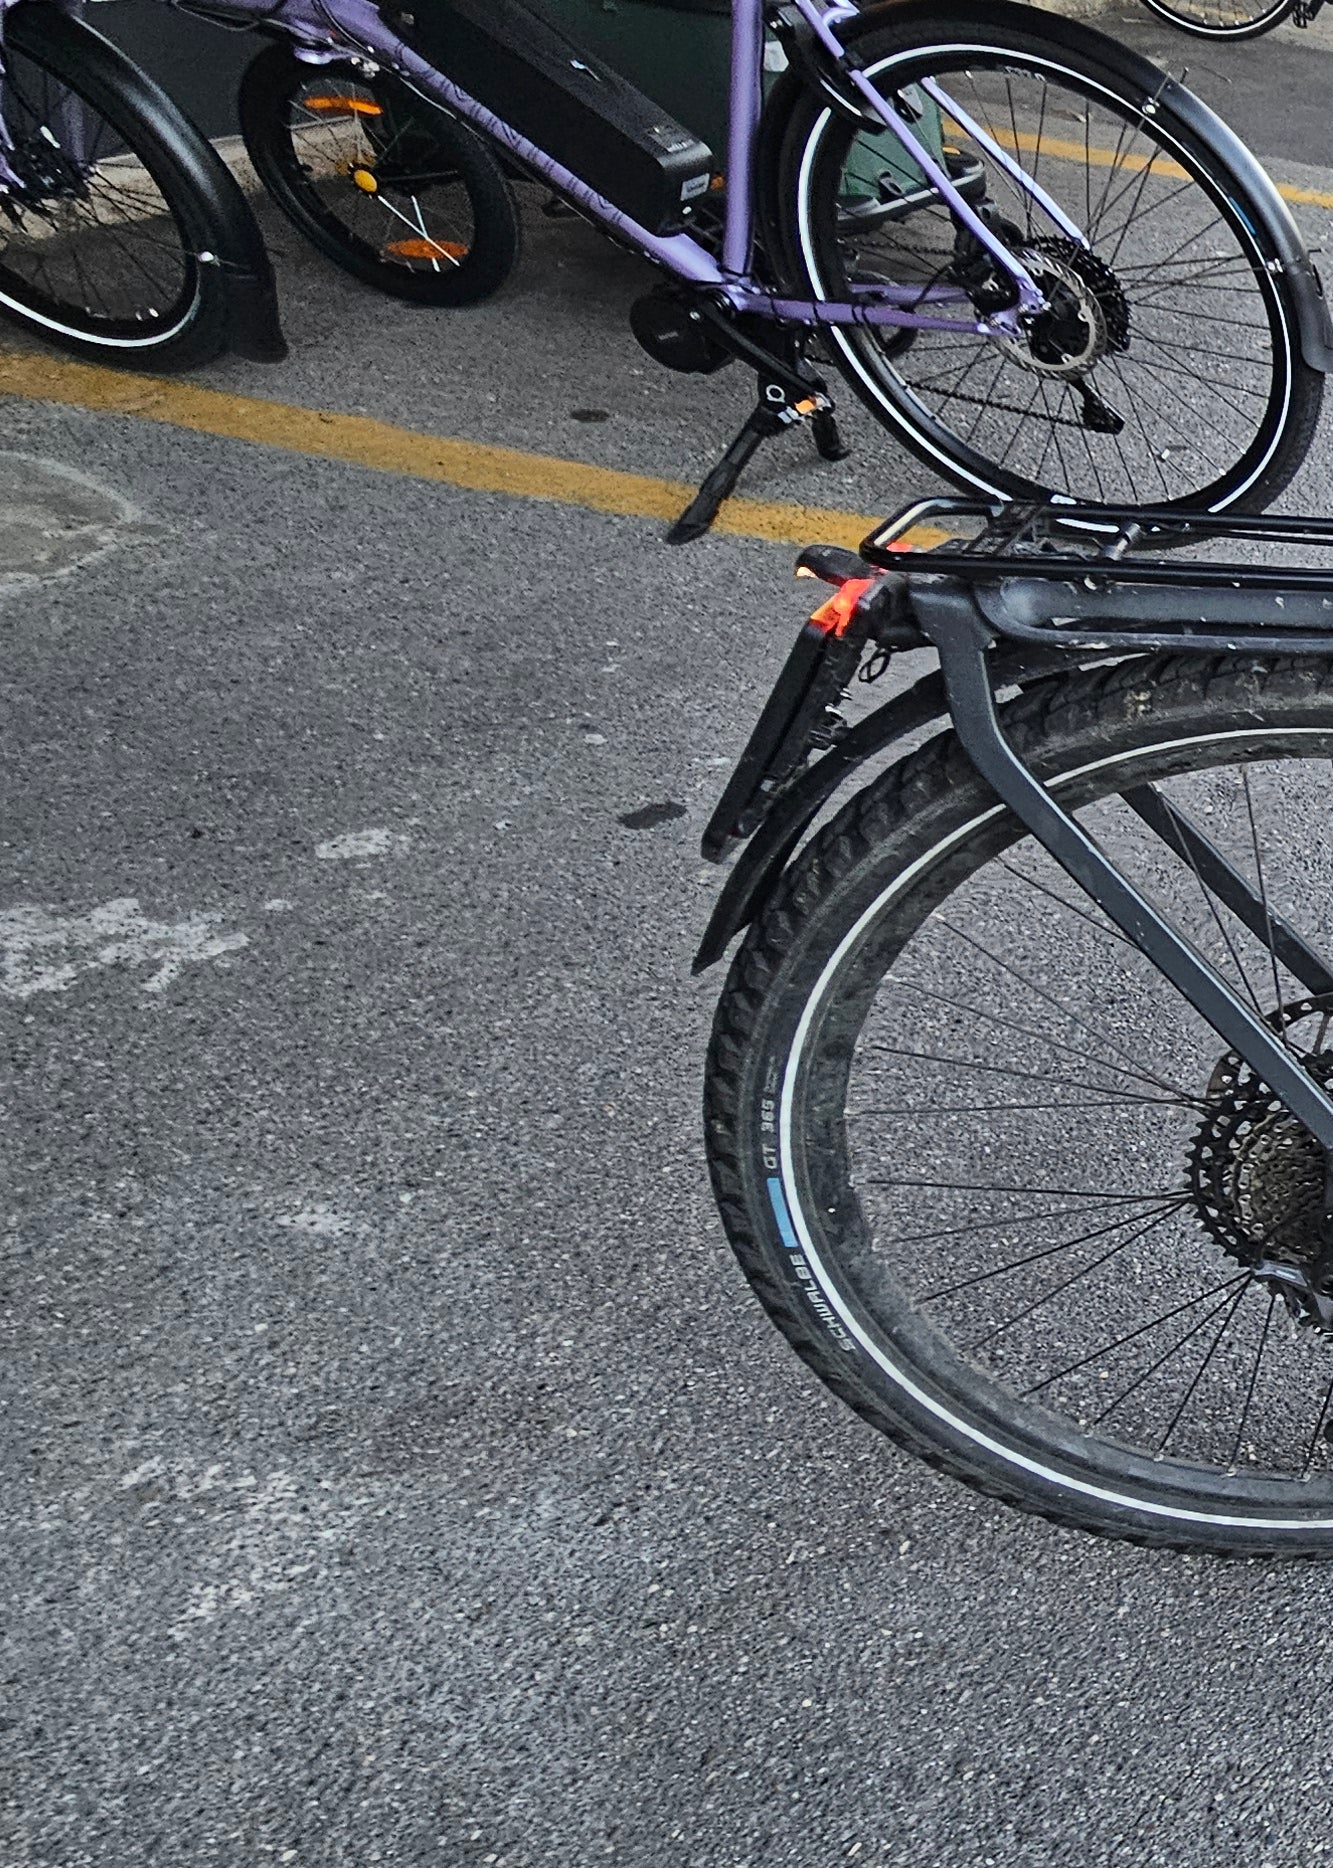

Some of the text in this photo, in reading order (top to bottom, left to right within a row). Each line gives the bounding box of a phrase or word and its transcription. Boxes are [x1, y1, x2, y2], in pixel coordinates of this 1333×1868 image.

[761, 1099, 776, 1133] 365
[762, 1143, 778, 1170] GT
[789, 1253, 857, 1352] SCHWALBE
